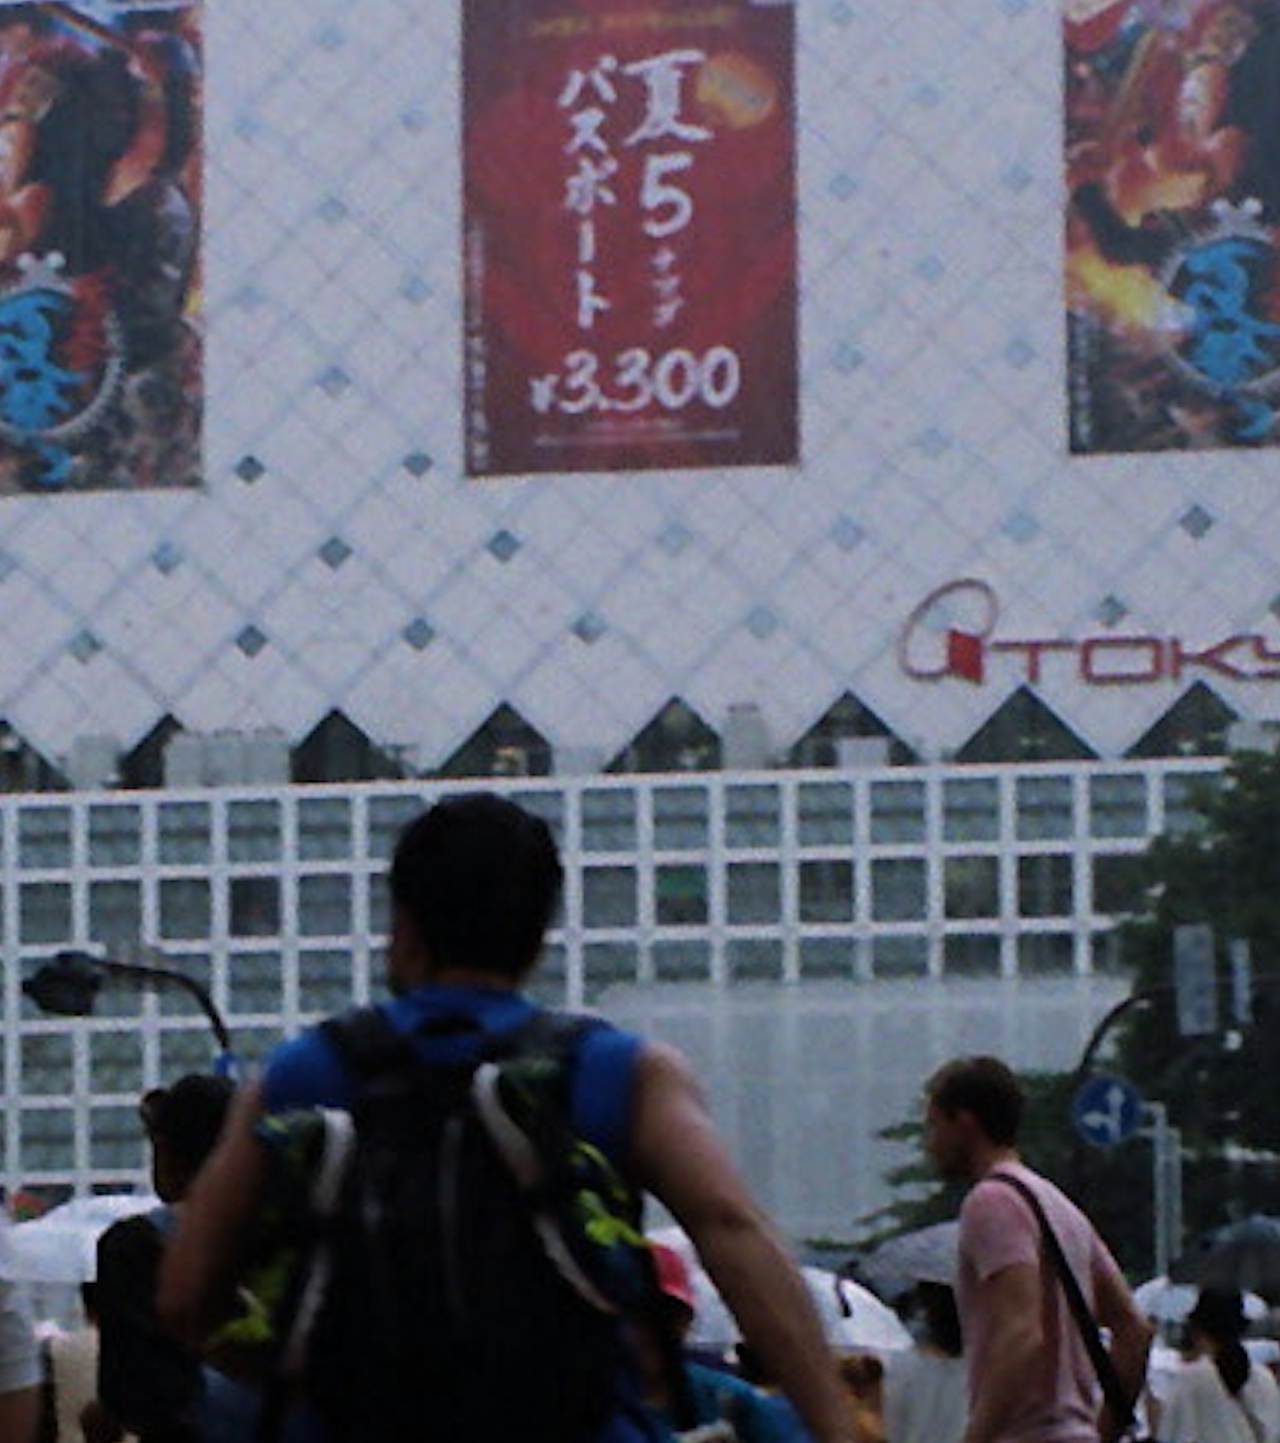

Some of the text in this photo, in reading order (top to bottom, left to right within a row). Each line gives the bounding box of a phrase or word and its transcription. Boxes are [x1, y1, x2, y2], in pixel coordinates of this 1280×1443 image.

[558, 53, 620, 330] パスポート
